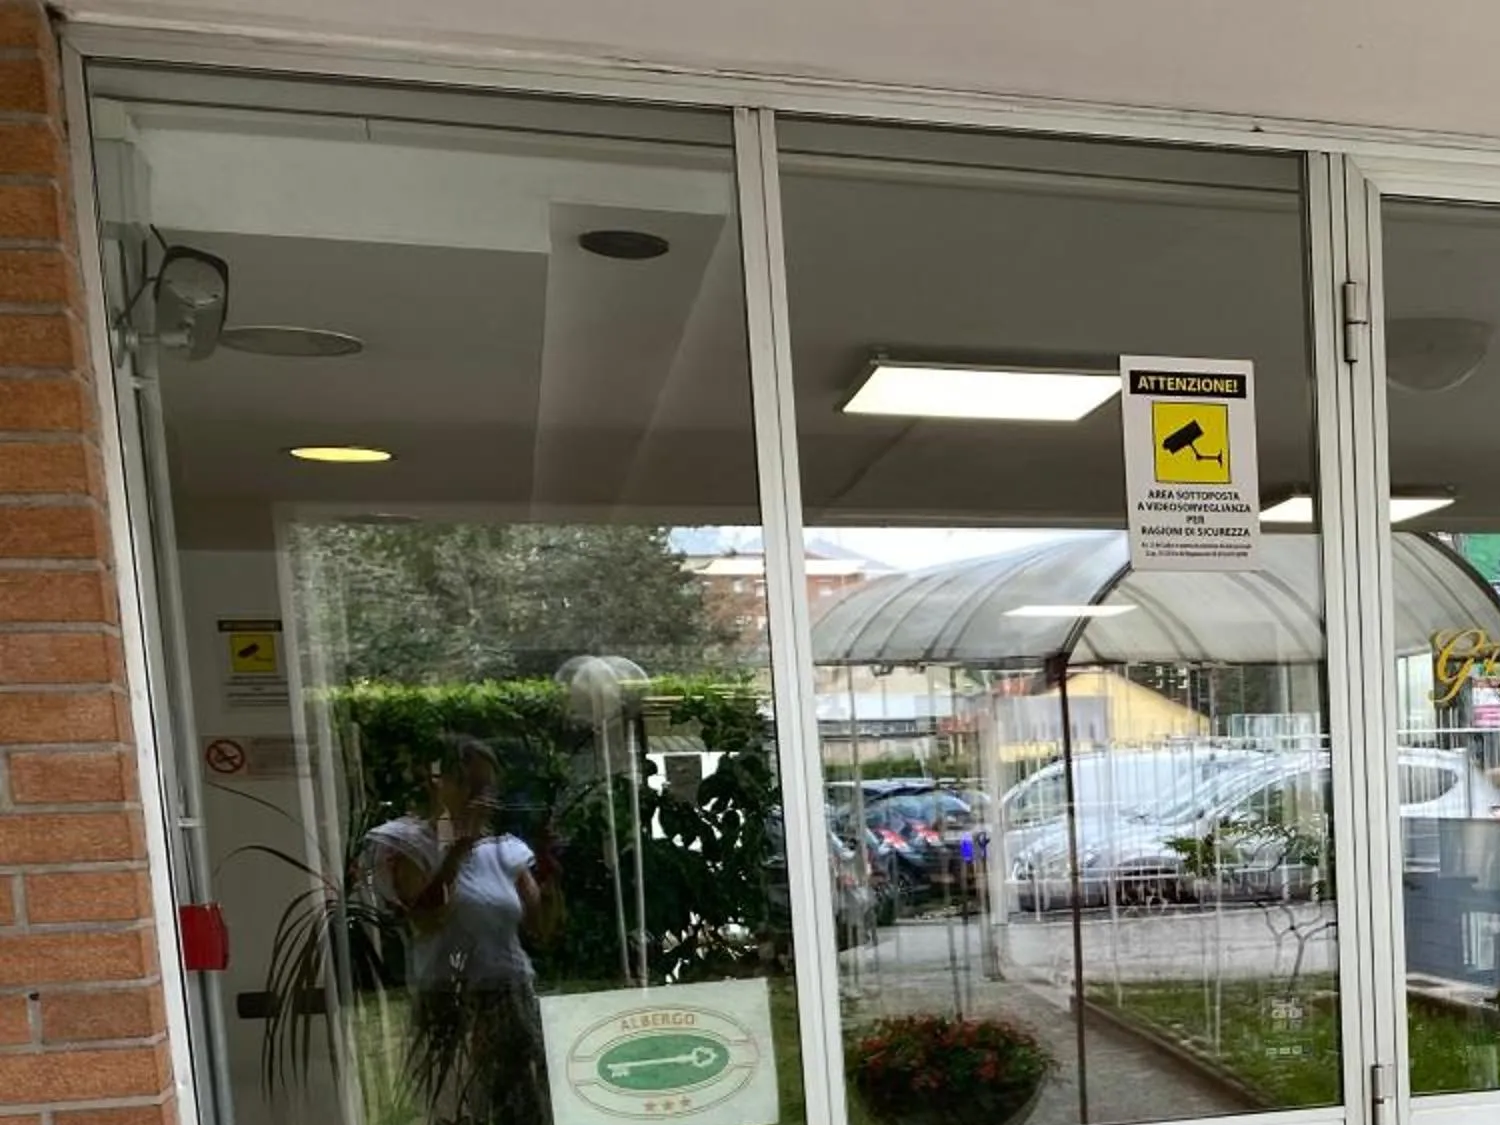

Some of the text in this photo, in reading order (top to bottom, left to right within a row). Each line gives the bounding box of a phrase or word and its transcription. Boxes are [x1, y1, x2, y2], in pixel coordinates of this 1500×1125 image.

[1137, 375, 1239, 393] ATTENZIONE!
[1148, 489, 1240, 501] AREA SOTTOPOSTA
[1186, 515, 1205, 524] PER
[1141, 526, 1251, 538] RAGIONI DI SICUREZZA
[620, 1013, 696, 1032] ALBERGO
